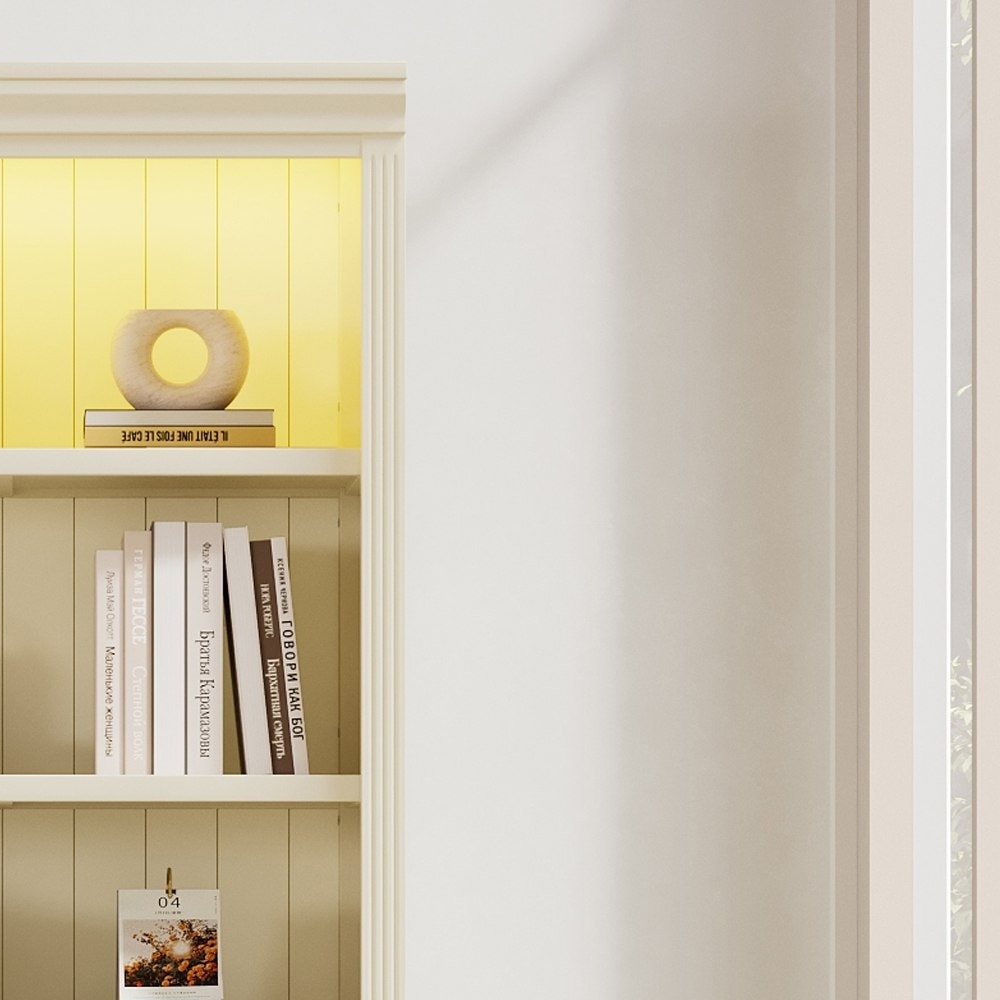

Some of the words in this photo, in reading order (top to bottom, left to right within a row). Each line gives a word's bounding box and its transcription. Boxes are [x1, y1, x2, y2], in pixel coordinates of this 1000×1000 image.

[122, 431, 142, 443] CAFÉ
[145, 431, 154, 441] LE
[157, 431, 174, 441] FOIS
[177, 431, 193, 441] UNE
[196, 431, 218, 443] ÉTAIT
[221, 431, 228, 441] IL
[134, 549, 143, 594] ГЕРМАН
[277, 558, 287, 585] КСЕНИЯ
[132, 598, 146, 645] ГЕССЕ
[195, 631, 214, 675] Братья
[282, 621, 297, 682] ГОВОРИ
[105, 646, 115, 704] Маленькие
[265, 658, 281, 718] Бархатная
[132, 666, 147, 726] Степной
[289, 688, 301, 711] КАК
[102, 707, 114, 757] женщины
[195, 680, 214, 758] Карамазовы
[292, 717, 304, 741] БОГ
[271, 720, 286, 759] смерть
[158, 896, 181, 908] 04
